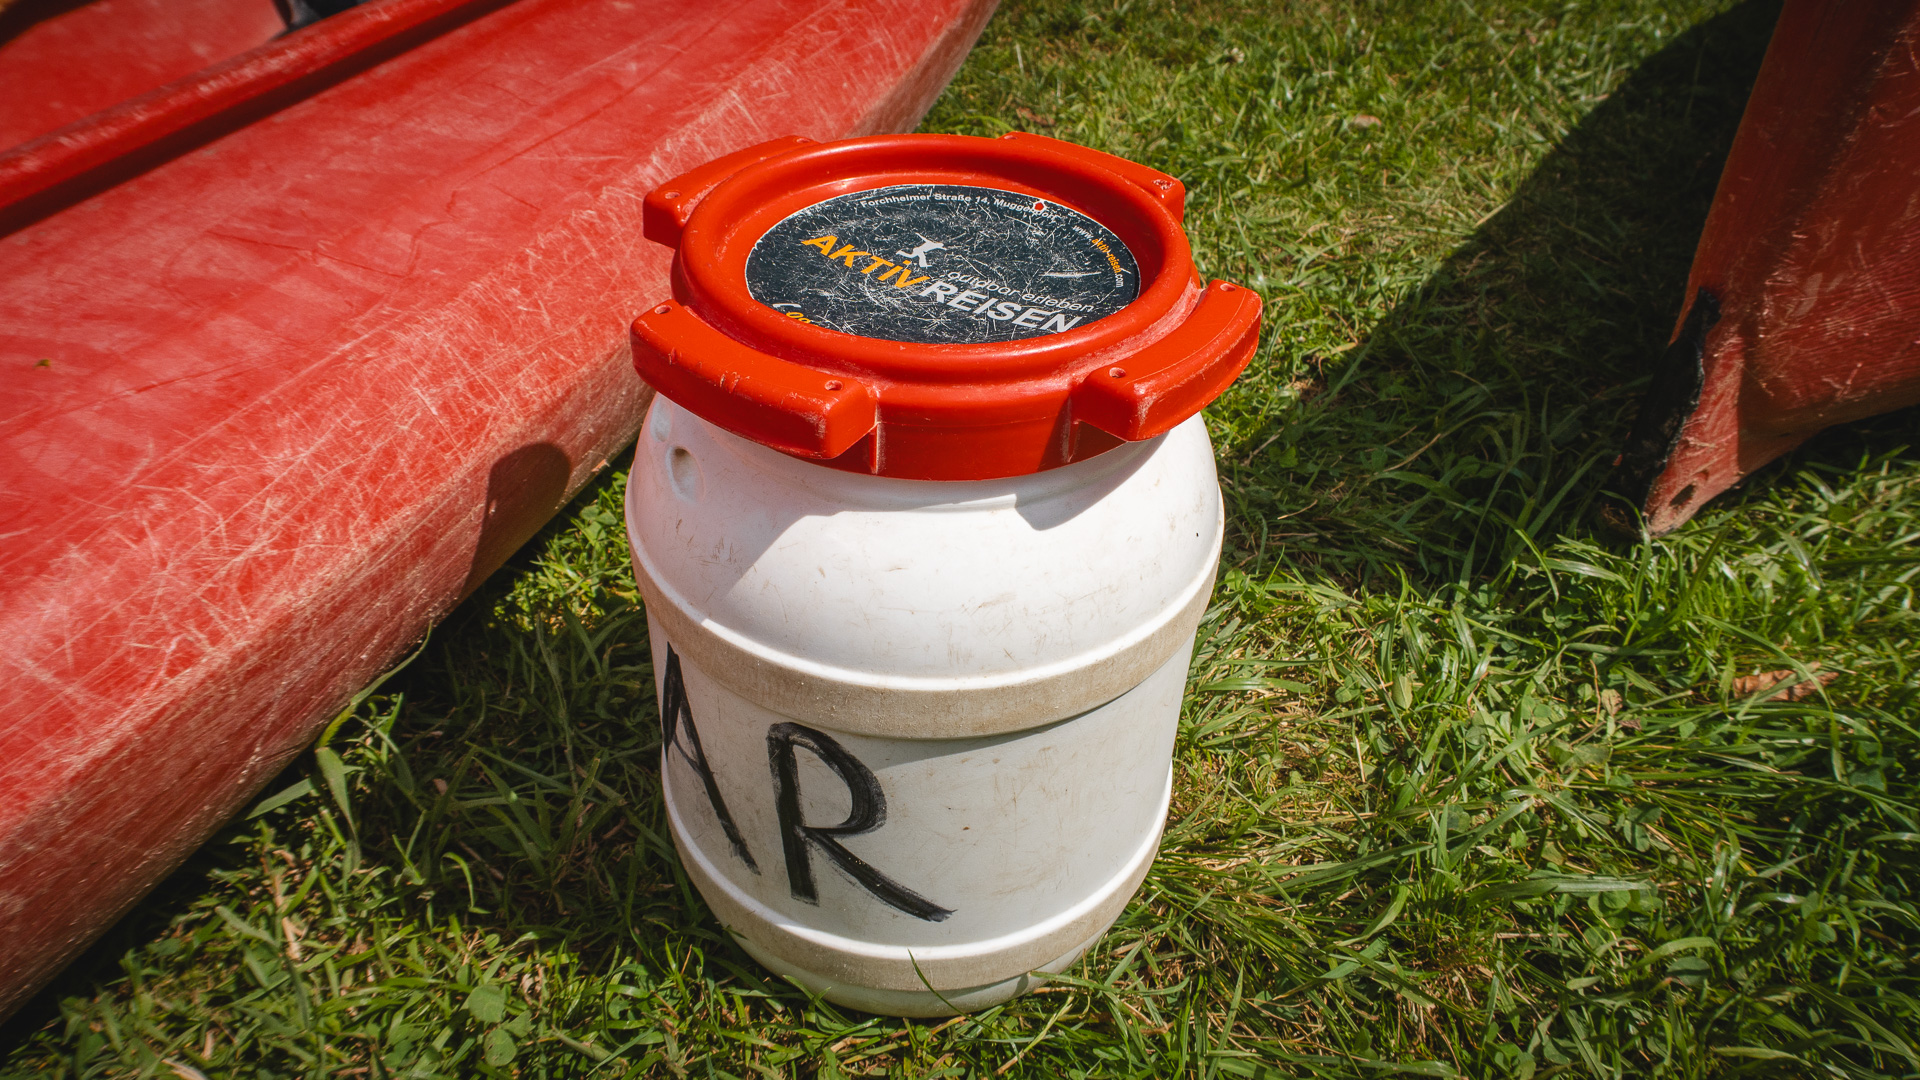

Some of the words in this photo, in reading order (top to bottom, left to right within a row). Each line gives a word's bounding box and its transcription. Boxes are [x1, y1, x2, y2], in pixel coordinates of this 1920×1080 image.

[860, 194, 931, 208] Forchheimer
[934, 193, 972, 202] Straße
[976, 196, 990, 205] 14,
[919, 281, 1083, 333] REISEN
[947, 271, 1021, 296] outdoor
[1021, 293, 1095, 313] erleben
